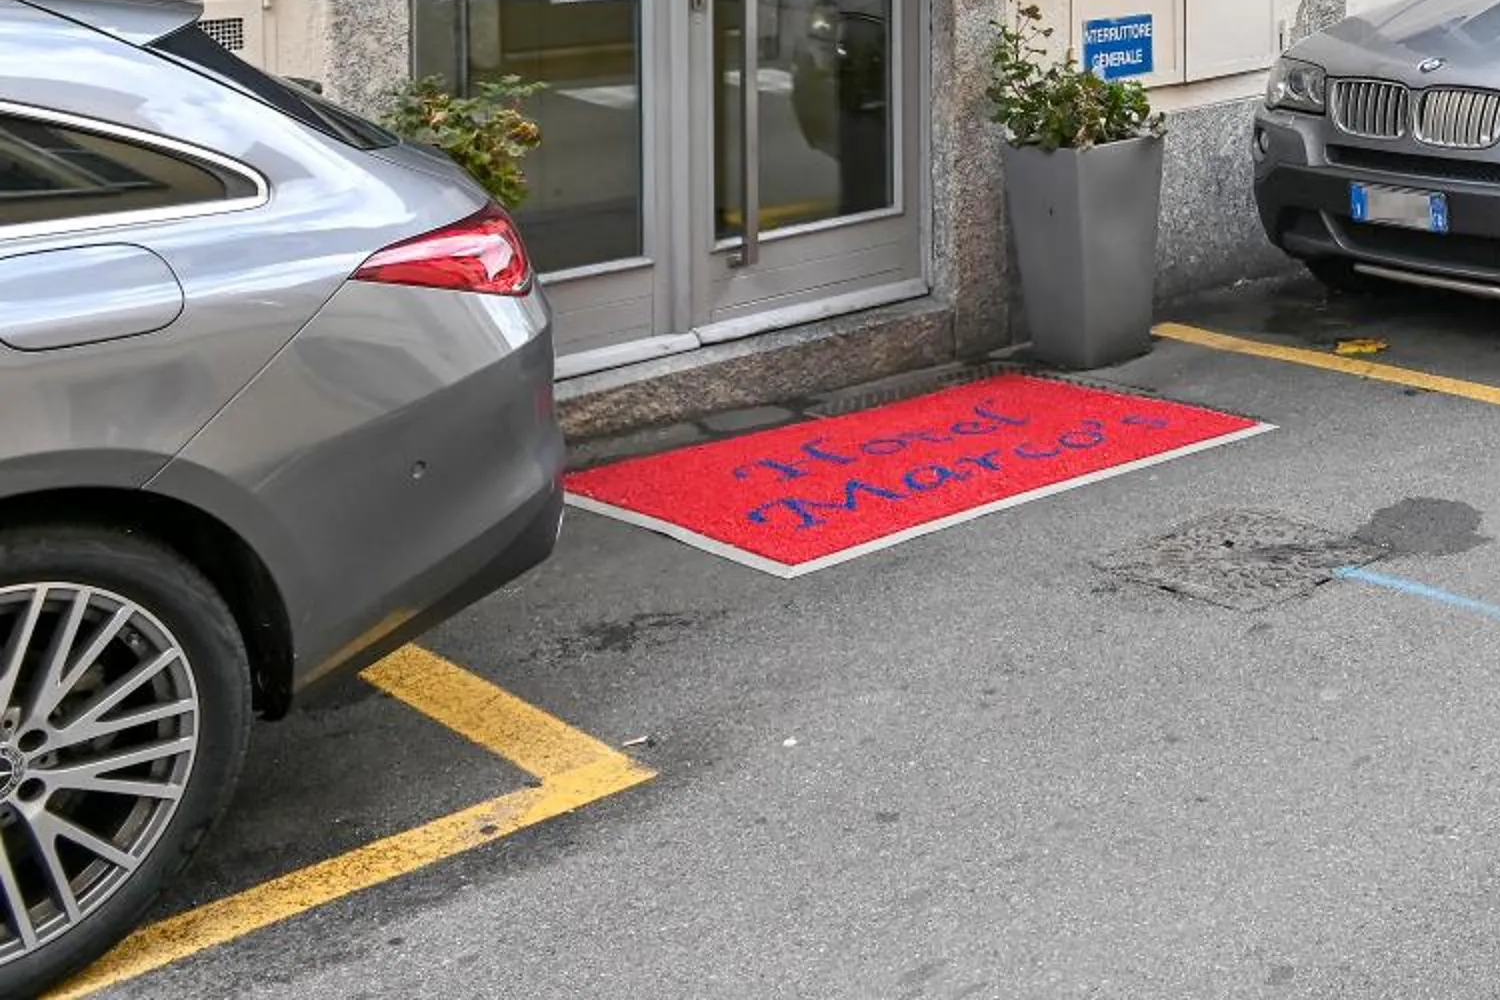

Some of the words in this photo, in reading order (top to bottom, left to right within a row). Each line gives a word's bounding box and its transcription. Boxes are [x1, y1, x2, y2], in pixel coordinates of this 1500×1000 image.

[1084, 23, 1152, 44] NTERRUTTORE
[735, 400, 1030, 482] Hotel
[747, 412, 1168, 530] Marco's
